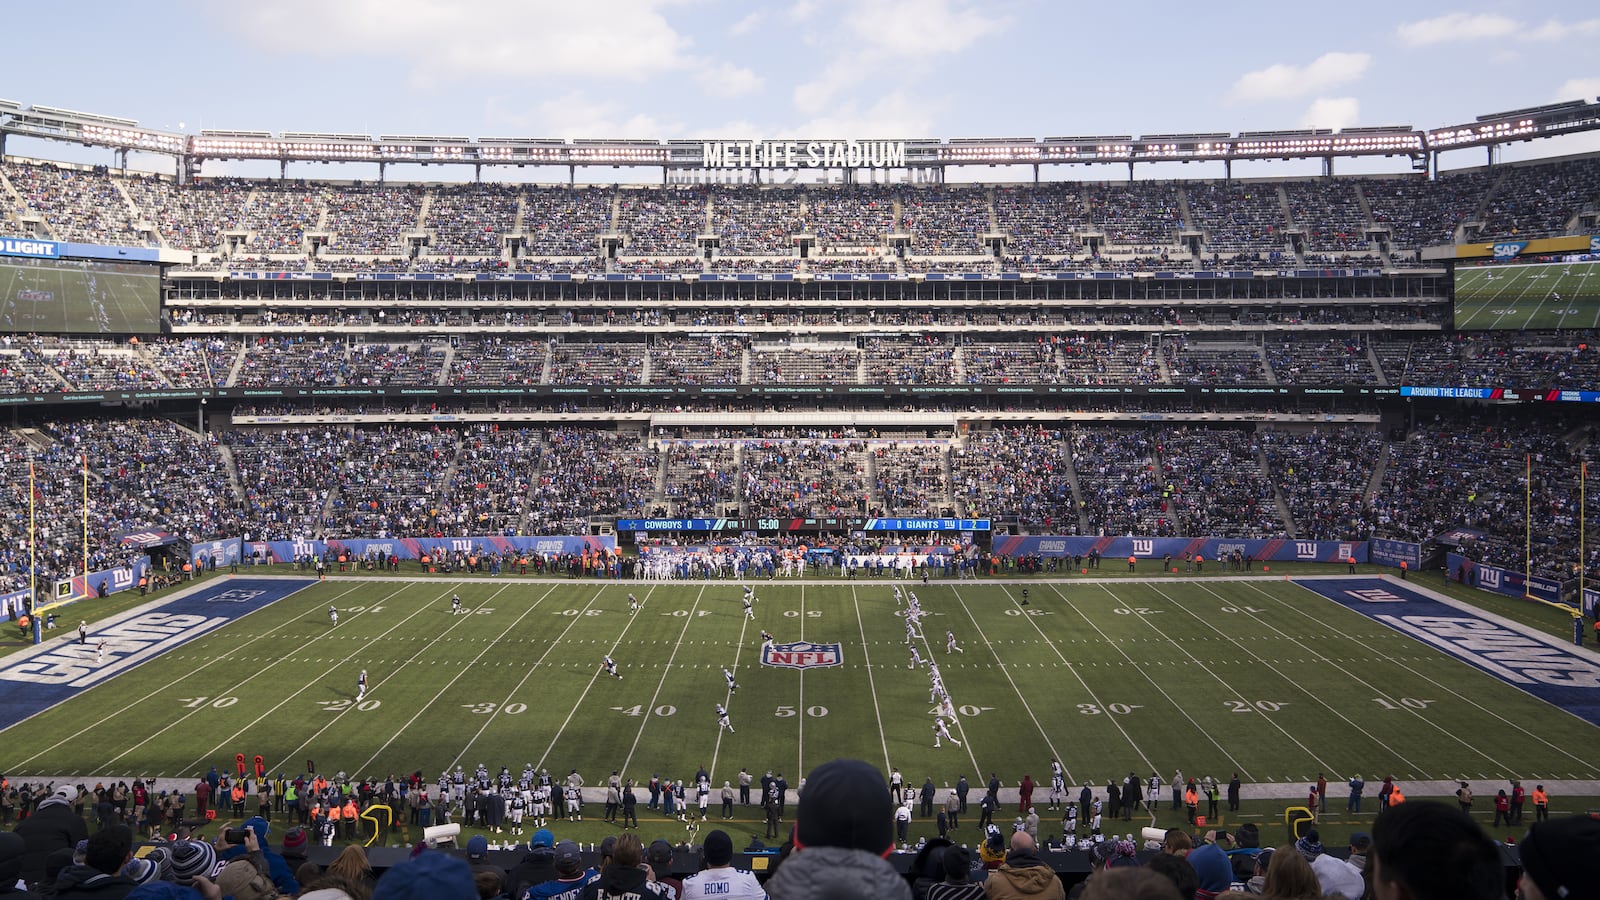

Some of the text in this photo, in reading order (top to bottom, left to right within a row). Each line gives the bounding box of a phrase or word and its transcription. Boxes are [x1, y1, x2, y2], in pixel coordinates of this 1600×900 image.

[704, 142, 906, 168] METLIFE STADIUM
[6, 240, 54, 256] LIGHT
[1494, 245, 1520, 256] SAP
[1411, 388, 1482, 398] AROUND THE LEAGUE
[687, 521, 692, 529] 0
[758, 519, 779, 530] 15:00
[366, 544, 393, 553] GIANTS
[537, 541, 563, 550] GIANTS
[1039, 541, 1066, 550] GIANTS
[1132, 540, 1152, 555] ny
[1296, 542, 1317, 558] ny
[112, 568, 133, 588] ny
[1480, 567, 1499, 588] ny
[62, 583, 69, 594] 2
[0, 612, 208, 685] GIANTS
[771, 653, 833, 665] NFL
[184, 696, 239, 708] 10
[326, 699, 382, 712] 20
[472, 702, 527, 714] 30
[1222, 700, 1280, 712] 20
[1373, 697, 1424, 708] 10
[624, 704, 677, 717] 40
[775, 704, 829, 717] 50
[1076, 703, 1133, 715] 30
[704, 882, 729, 894] ROMO
